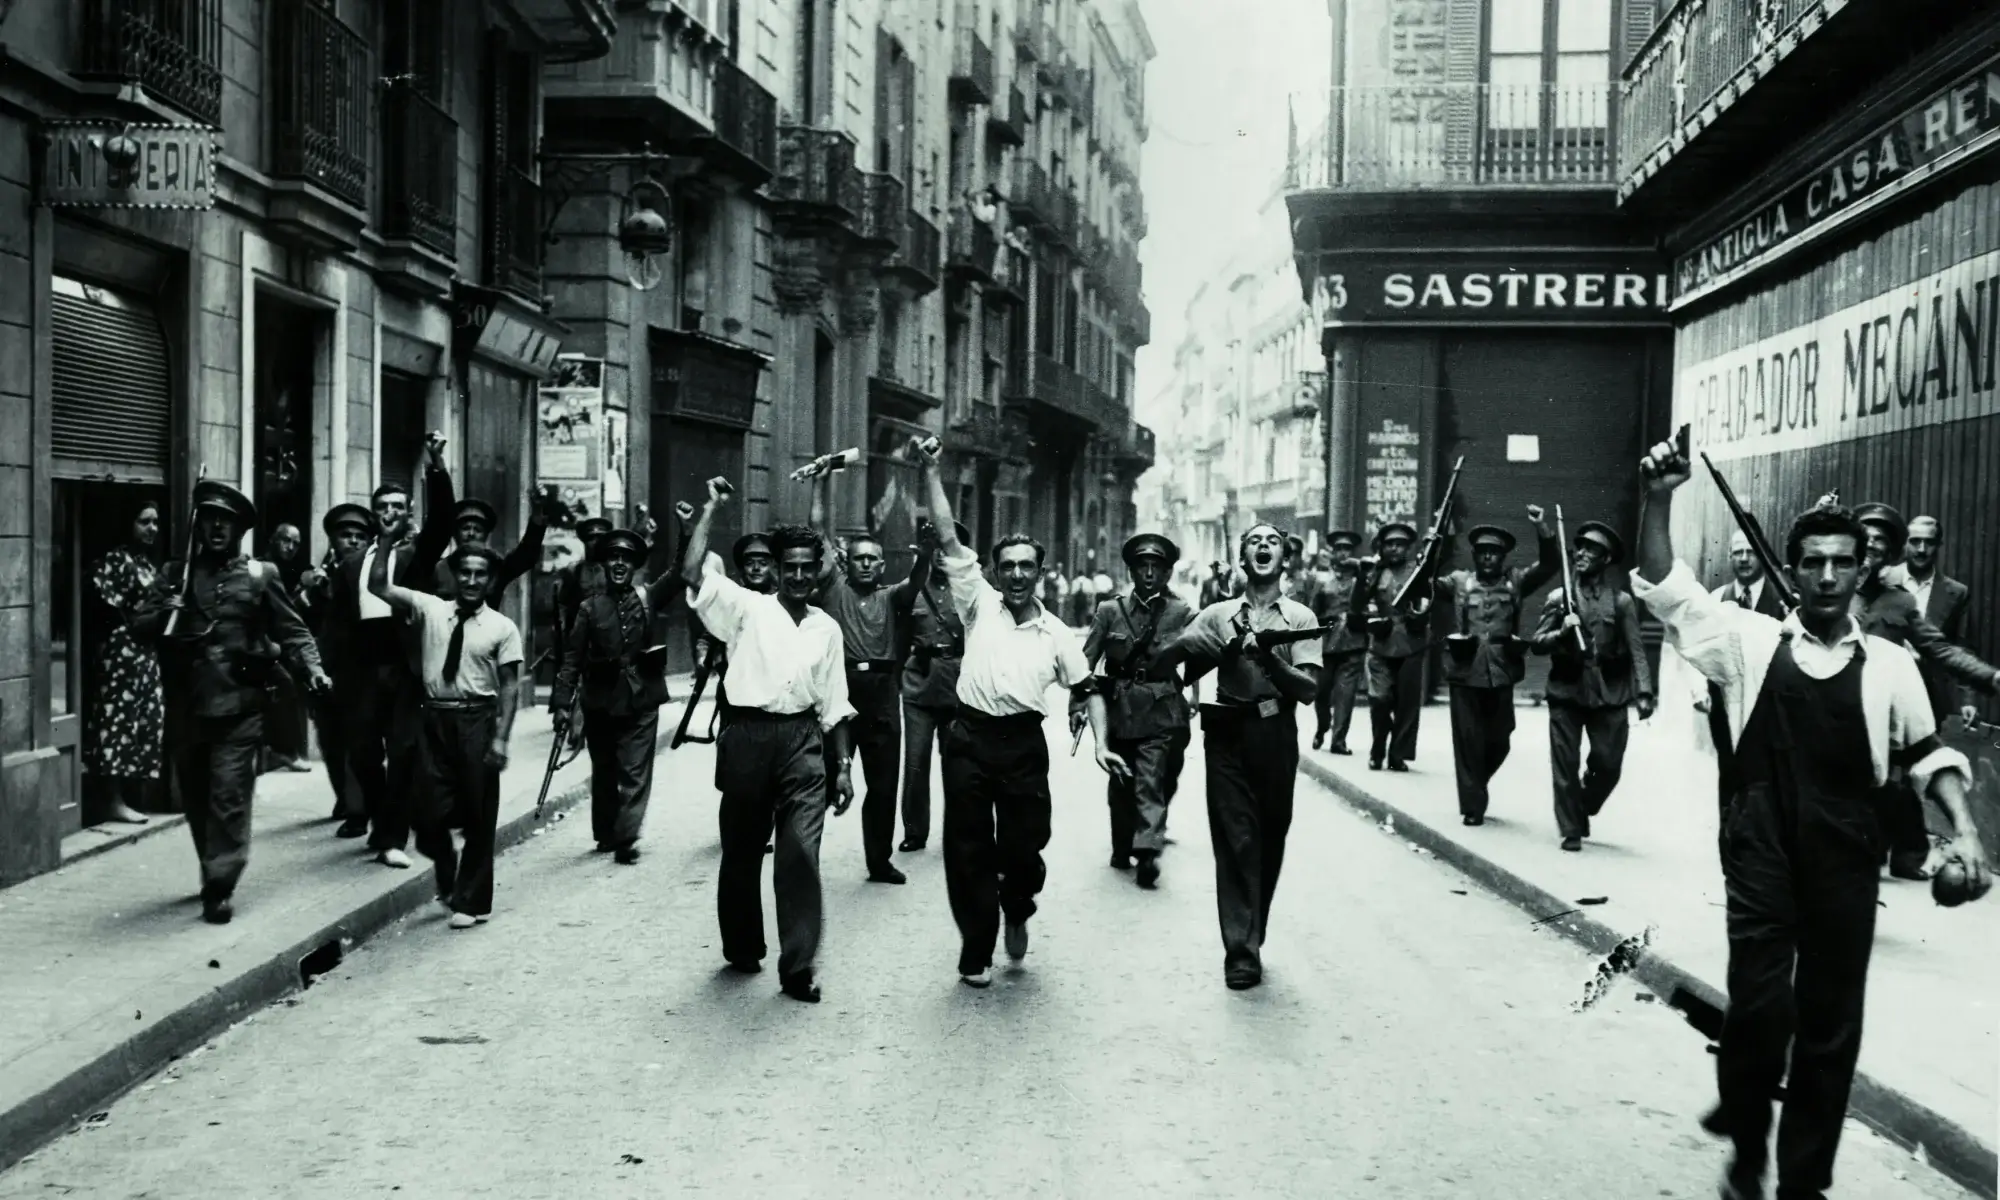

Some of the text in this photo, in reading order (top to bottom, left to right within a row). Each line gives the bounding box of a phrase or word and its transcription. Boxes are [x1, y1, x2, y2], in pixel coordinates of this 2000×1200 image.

[42, 138, 208, 192] INTRERIA
[1696, 203, 1790, 284] ANTIGUA
[1806, 131, 1901, 218] CASA
[1383, 273, 1668, 307] SASTRERI
[1841, 274, 2000, 422] MECÁNI
